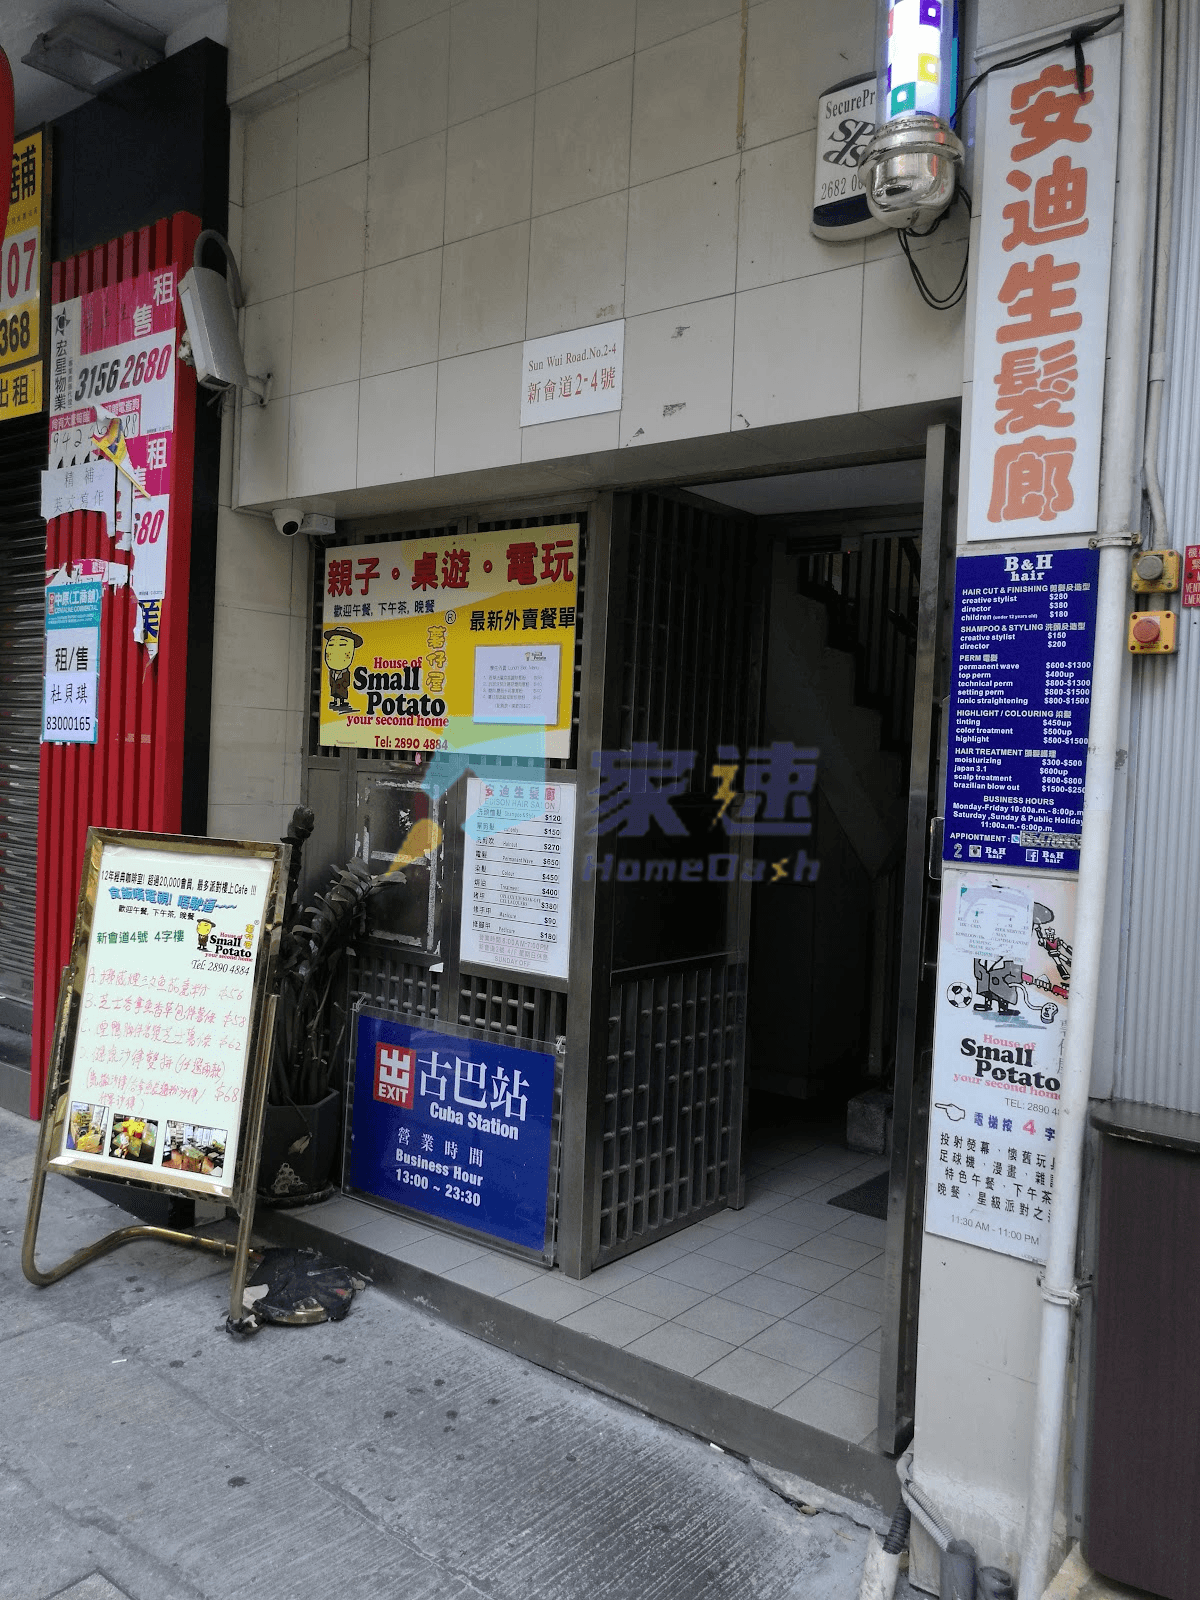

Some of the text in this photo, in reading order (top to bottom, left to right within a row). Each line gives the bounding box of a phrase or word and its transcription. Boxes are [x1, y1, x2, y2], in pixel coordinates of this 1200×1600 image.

[821, 177, 847, 201] 2682
[153, 271, 174, 307] 租
[987, 64, 1094, 524] 安迪生髮廊
[133, 303, 153, 338] 售
[528, 360, 544, 372] Sun
[547, 354, 563, 368] Wui
[54, 339, 68, 412] 宏星物業
[74, 344, 173, 402] 3156 2680
[527, 366, 616, 404] 新會道2-4號
[147, 438, 167, 470] 租
[1010, 570, 1045, 582] hair
[1006, 585, 1048, 594] FINISHING
[961, 593, 1068, 605] creative stylist $280
[961, 601, 1068, 613] director $380
[469, 606, 576, 632] 最新外賣餐單
[961, 610, 1069, 621] children $180
[960, 623, 1044, 633] SHAMPOO STYLING
[960, 631, 1067, 642] creative stylist $150
[959, 640, 1067, 650] director $200
[55, 646, 89, 672] 租/售
[373, 656, 423, 670] House of
[959, 654, 982, 662] PERM
[958, 663, 999, 671] permanent
[1045, 661, 1091, 669] $600-$1300
[352, 666, 421, 692] Small
[958, 670, 1075, 680] top perm $400up
[957, 680, 993, 688] technical
[993, 681, 1014, 689] perm
[51, 683, 88, 704] 杜貝琪
[957, 688, 984, 697] setting
[984, 689, 1005, 697] perm
[365, 691, 446, 717] Potato
[976, 697, 1029, 706] straightening
[956, 709, 1054, 718] HIGHLIGHT COLOURING
[46, 716, 91, 731] 83000165
[346, 714, 450, 728] your second home
[956, 718, 1072, 728] tinting $450up
[955, 727, 1073, 737] color treatment $500up
[374, 735, 449, 751] Tel: 2890 4884
[955, 735, 990, 743] highlight
[955, 747, 1024, 756] HAIR TREATMENT
[954, 756, 1002, 766] moisturizing
[953, 764, 1069, 776] japan 3.1 $600up
[953, 773, 974, 782] scalp
[975, 774, 1013, 782] treatment
[953, 782, 986, 790] brazilian
[987, 782, 1006, 790] blow
[511, 799, 529, 808] HAIR
[530, 801, 556, 810] SALON
[983, 795, 1055, 806] BUSINESS HOURS
[952, 802, 1009, 813] Monday-Friday
[544, 814, 561, 822] $120
[953, 811, 1053, 824] Saturday Public
[543, 843, 560, 852] $270
[542, 873, 559, 882] $450
[541, 888, 558, 897] $400
[543, 916, 557, 925] $90
[96, 930, 185, 945] 新會道4號 4字樓
[209, 935, 242, 947] Small
[539, 931, 557, 941] $180
[215, 945, 252, 958] Potato
[207, 961, 229, 973] 2890
[229, 964, 251, 976] 4884
[983, 1033, 1036, 1051] House of
[960, 1037, 1034, 1068] Small
[975, 1058, 1061, 1092] Potato
[417, 1050, 531, 1122] 古巴站
[953, 1071, 982, 1086] your
[984, 1077, 1027, 1095] second
[378, 1082, 409, 1104] EXIT
[1005, 1098, 1050, 1115] TEL: 2890
[429, 1101, 519, 1141] Cuba Station
[1023, 1119, 1037, 1136] 4
[398, 1126, 484, 1168] 營業時間
[395, 1147, 484, 1187] Business Hour
[396, 1168, 481, 1207] 13:00 23:30
[950, 1213, 1040, 1246] 11:30 AM 11:00 PM
